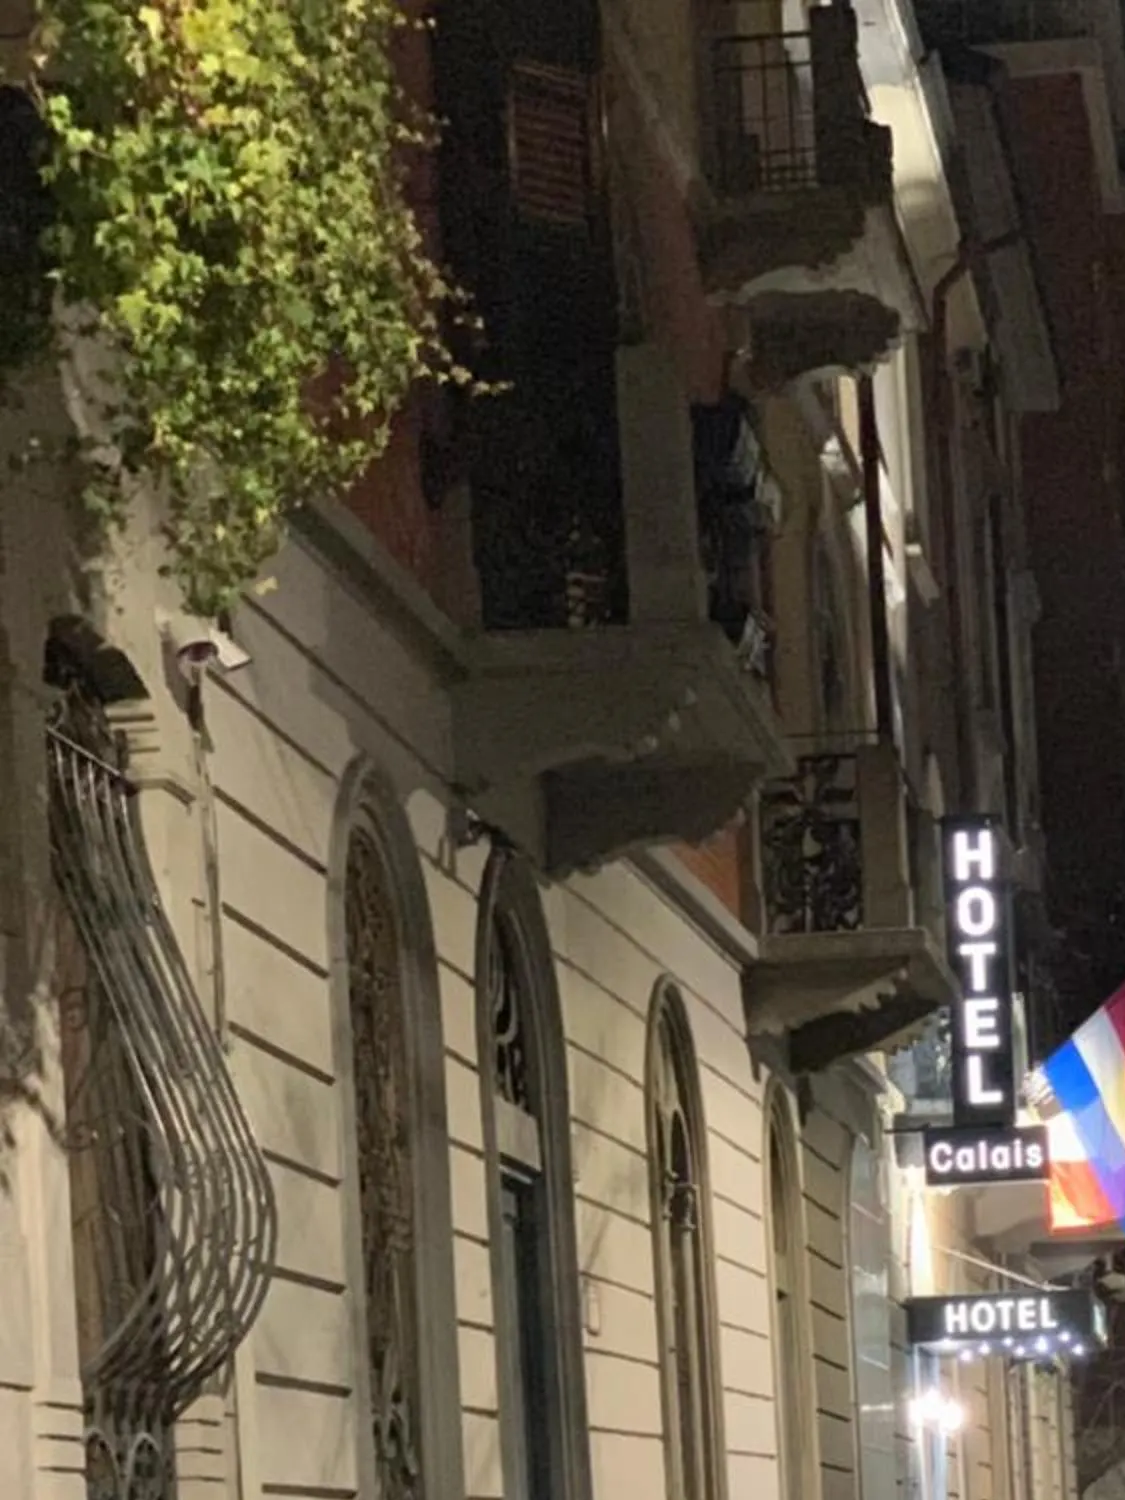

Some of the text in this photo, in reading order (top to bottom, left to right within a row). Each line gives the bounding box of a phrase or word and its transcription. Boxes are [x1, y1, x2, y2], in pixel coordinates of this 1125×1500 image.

[952, 829, 1003, 1106] HOTEL
[929, 1138, 1044, 1174] Calais
[944, 1299, 1059, 1334] HOTEL
